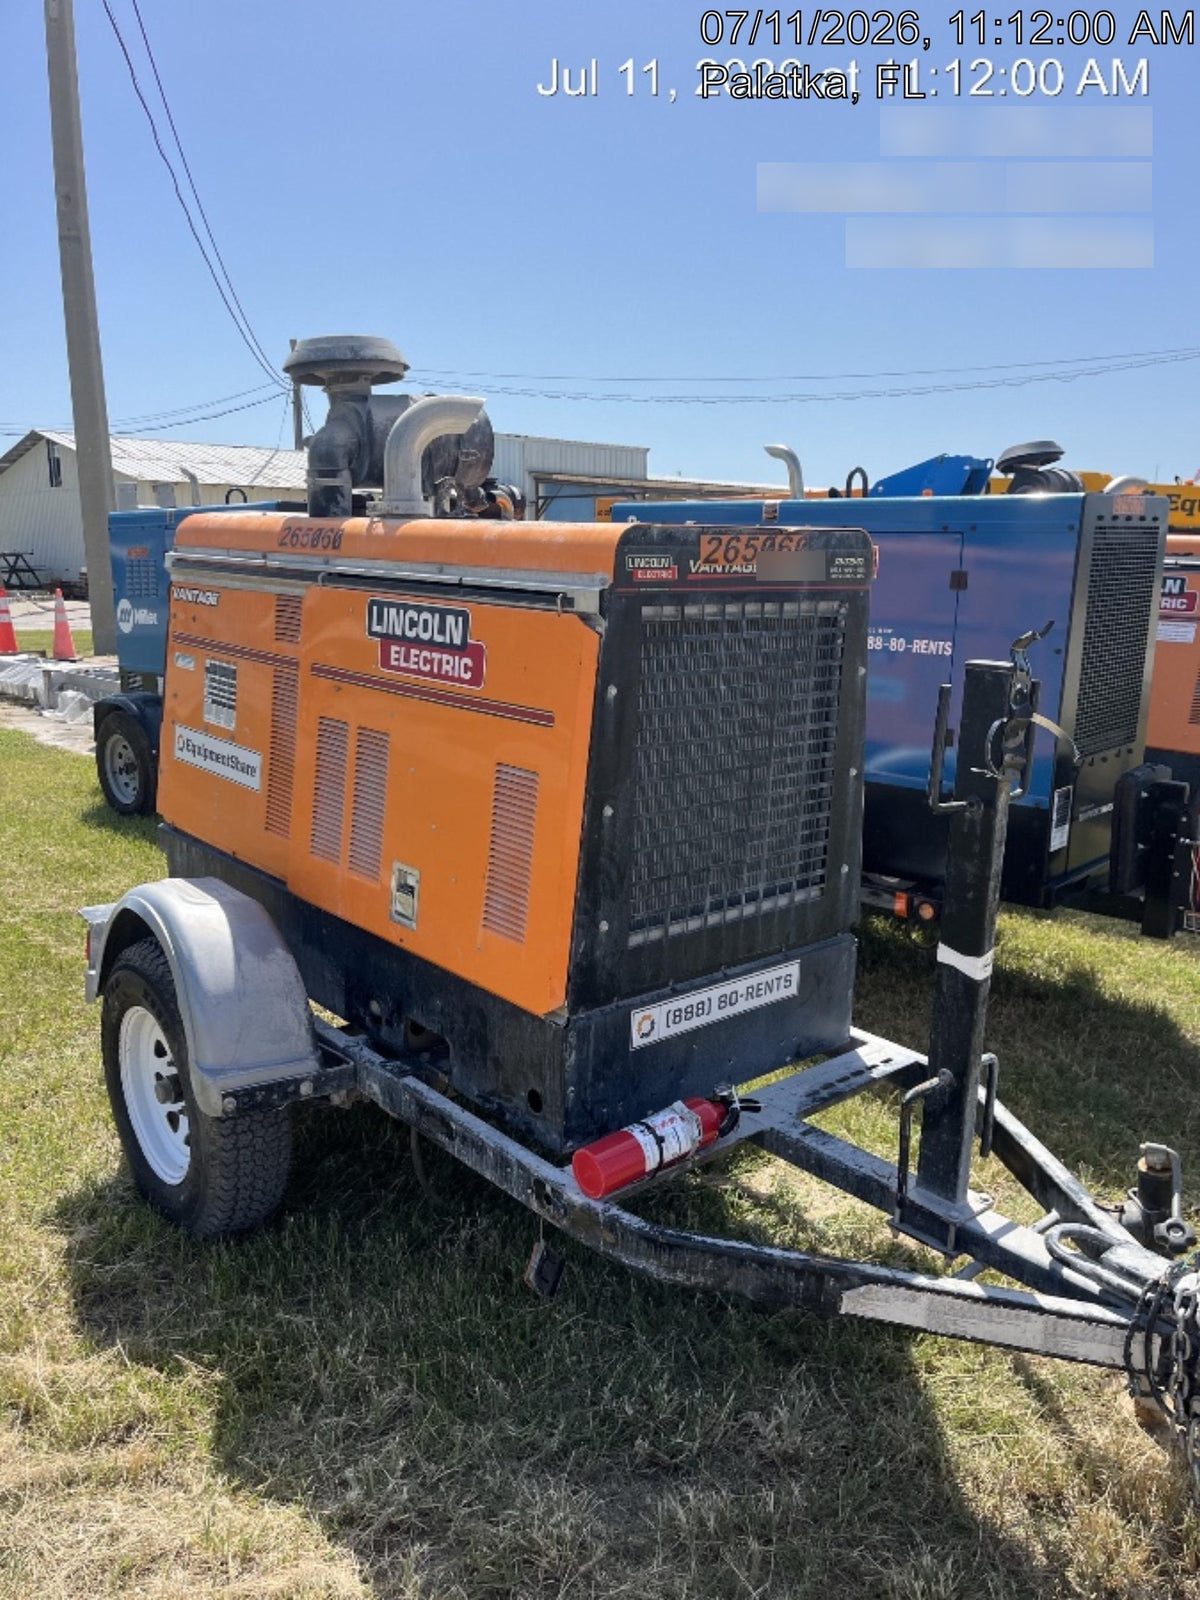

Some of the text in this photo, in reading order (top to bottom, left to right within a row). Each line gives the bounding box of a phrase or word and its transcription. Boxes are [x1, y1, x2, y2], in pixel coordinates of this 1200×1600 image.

[1166, 494, 1200, 516] Eq
[628, 557, 669, 568] LINCOLN
[172, 586, 221, 607] VANTAGE
[371, 605, 463, 646] LINCOLN
[390, 644, 474, 680] ELECTRIC
[185, 736, 258, 778] EquipmentShare
[665, 973, 794, 1028] (888) 80-RENTS
